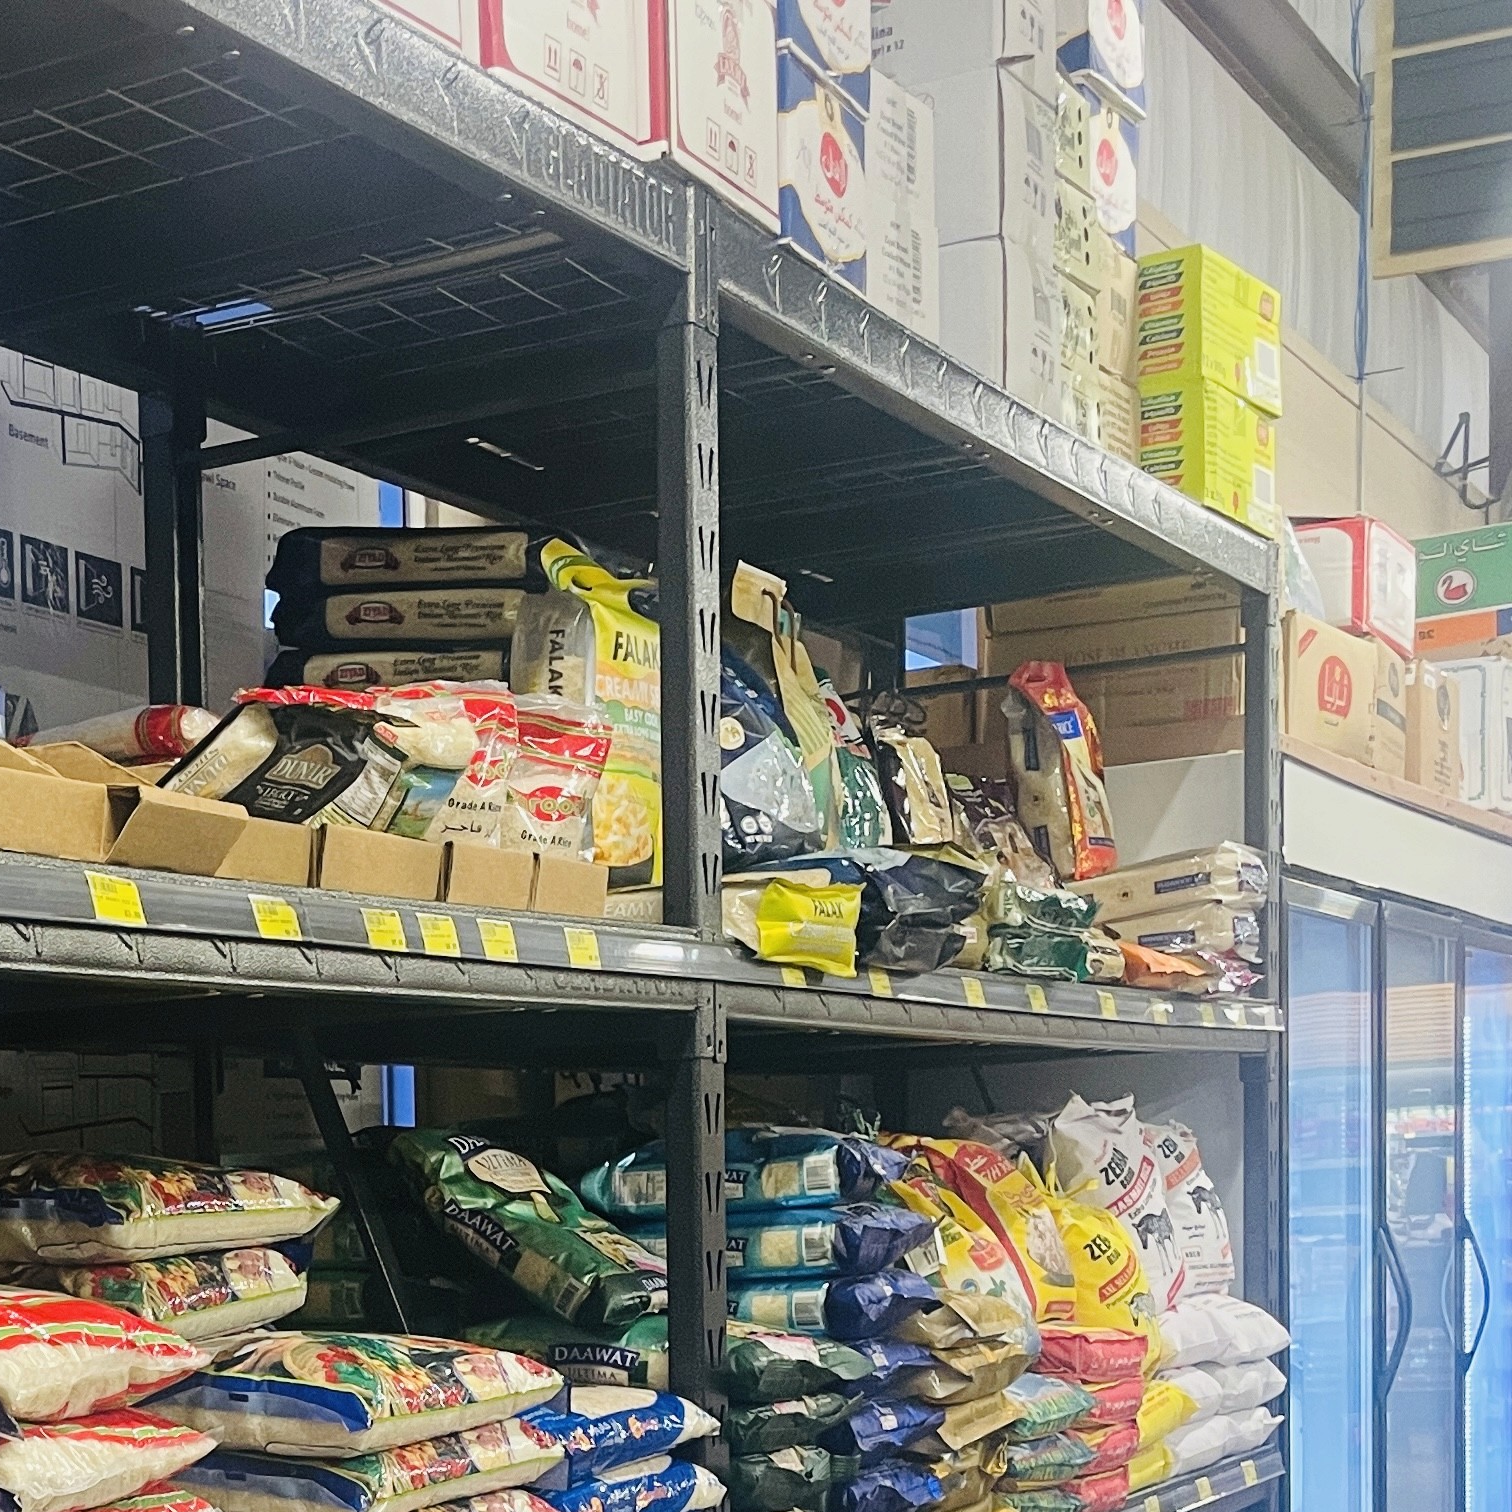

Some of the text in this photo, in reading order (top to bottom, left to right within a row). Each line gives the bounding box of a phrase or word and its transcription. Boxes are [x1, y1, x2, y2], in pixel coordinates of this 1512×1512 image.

[8, 424, 50, 449] Basement
[275, 758, 333, 785] DUNAR
[444, 1202, 517, 1250] DAAWAT
[554, 1346, 638, 1369] DAAWAT
[567, 1366, 618, 1382] ULTIMA
